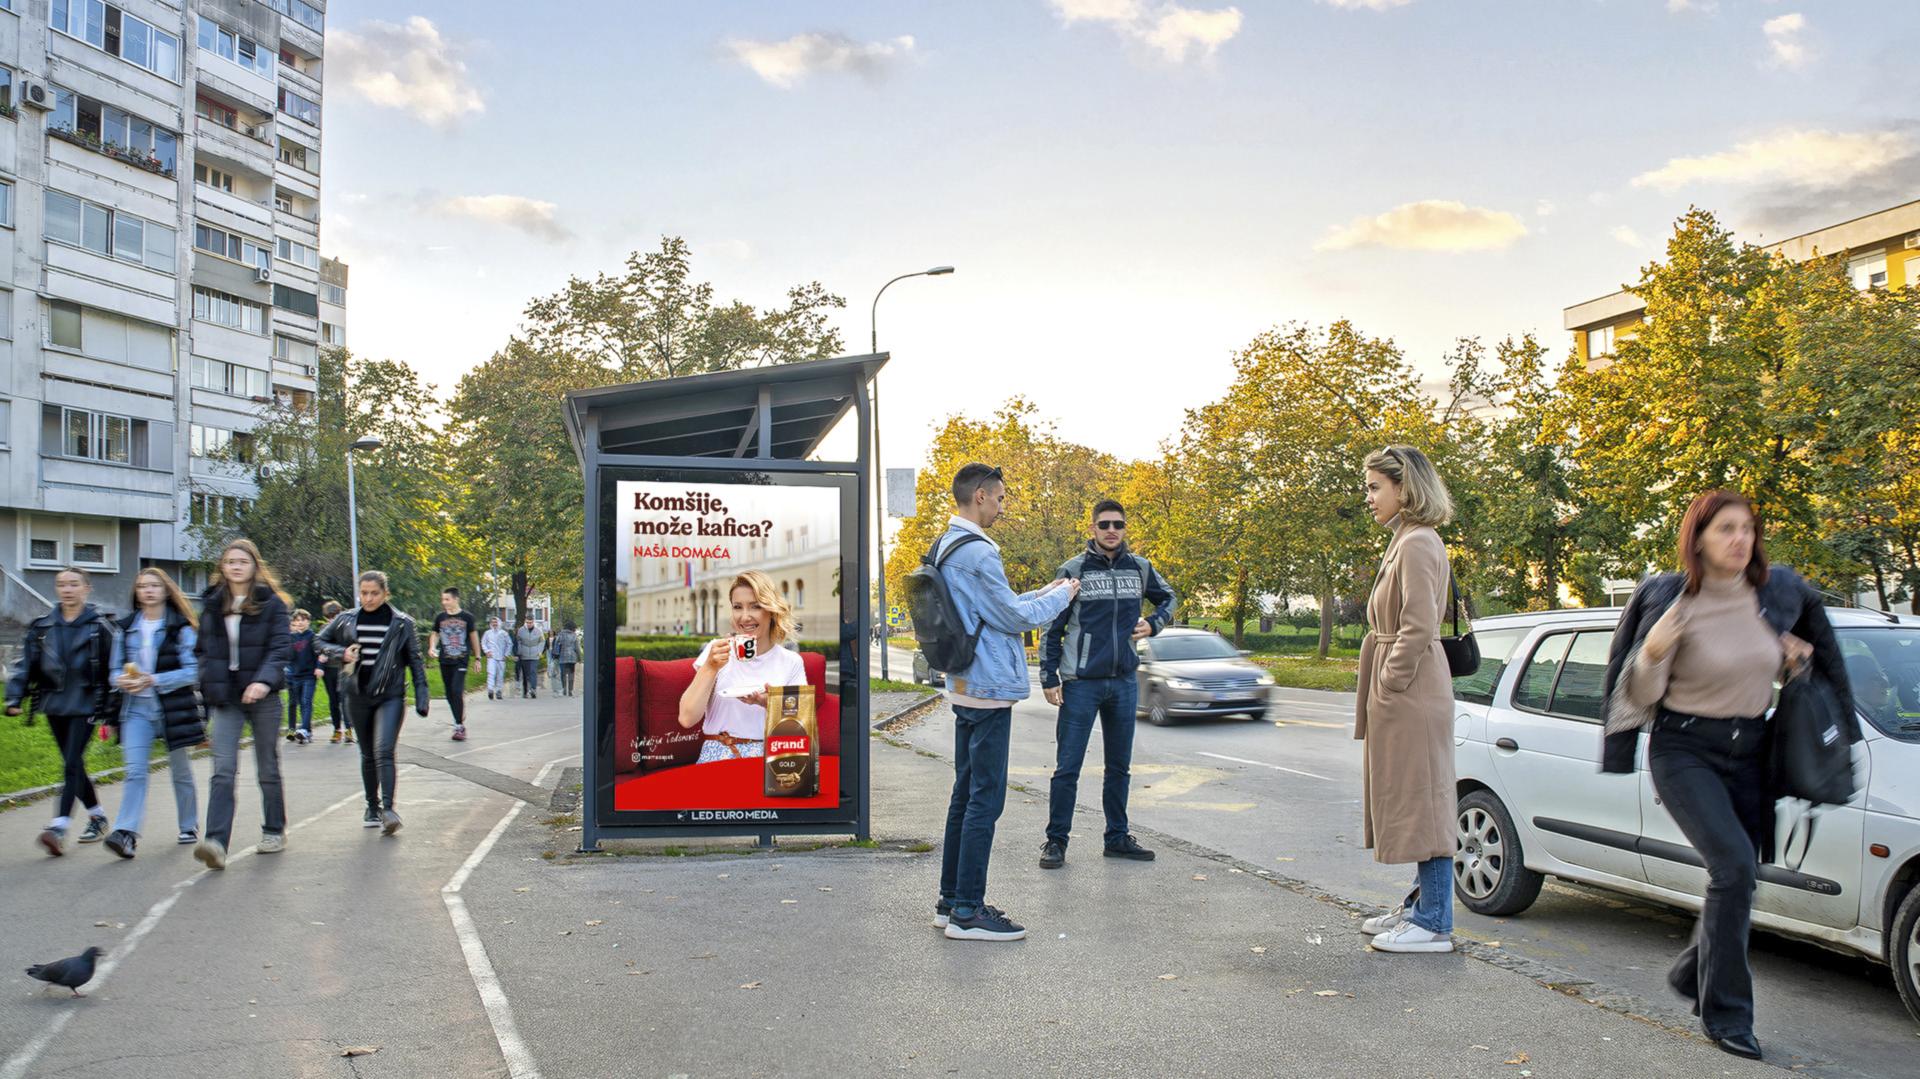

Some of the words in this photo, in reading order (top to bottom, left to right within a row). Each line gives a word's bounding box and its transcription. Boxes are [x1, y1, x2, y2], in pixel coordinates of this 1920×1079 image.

[634, 491, 729, 516] Komšije,
[633, 515, 693, 536] može
[697, 517, 774, 538] kafica?
[633, 543, 670, 558] NAŠA
[672, 544, 731, 560] DOMAĆA
[770, 739, 805, 753] grand
[691, 811, 714, 820] LED
[715, 810, 745, 820] EURO
[745, 810, 779, 820] MEDIA
